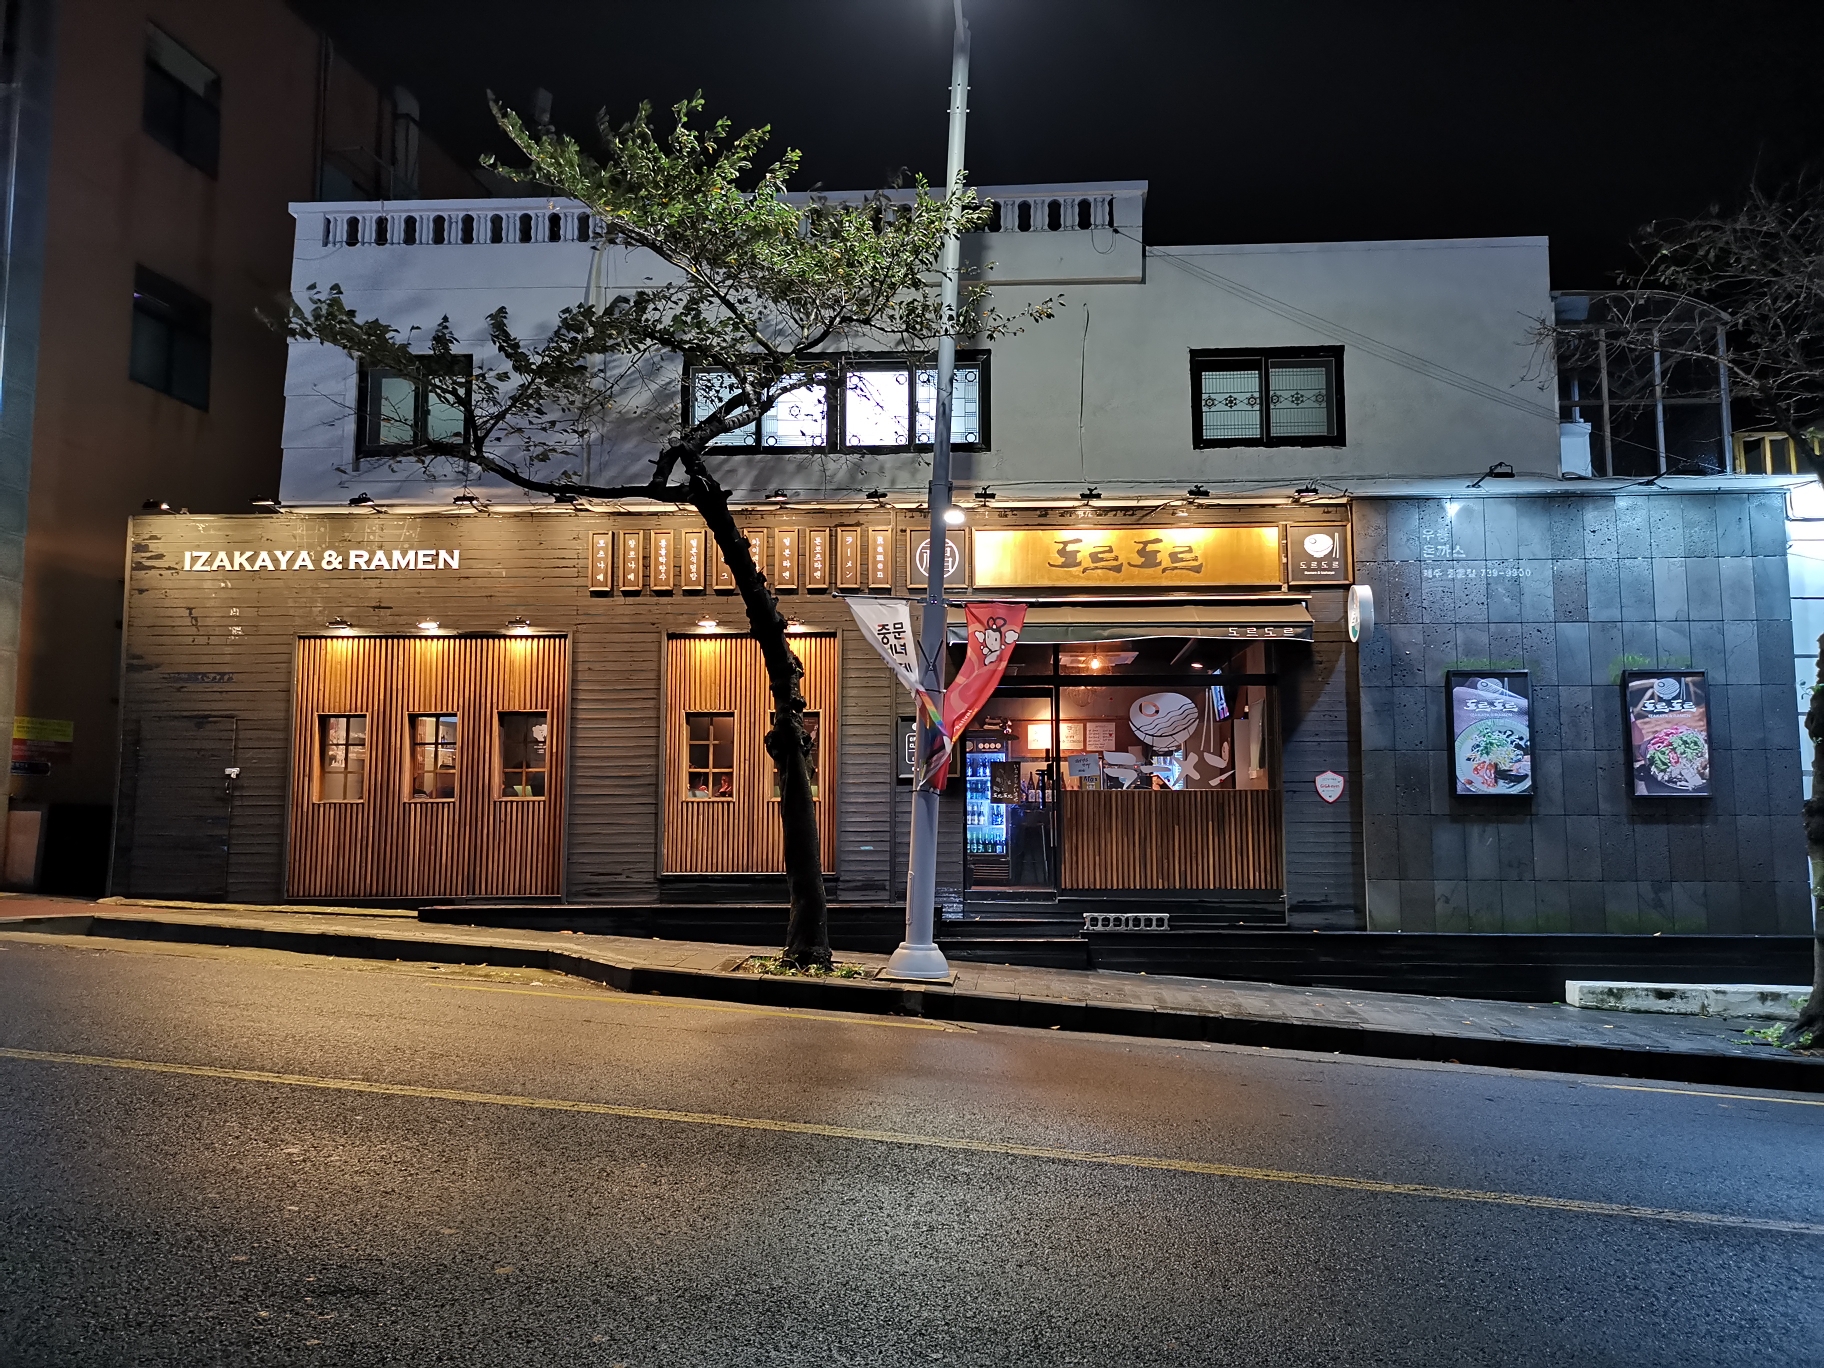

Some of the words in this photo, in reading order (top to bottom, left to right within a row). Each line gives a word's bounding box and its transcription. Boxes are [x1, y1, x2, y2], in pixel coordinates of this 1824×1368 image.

[183, 550, 315, 571] IZAKAYA
[321, 549, 343, 570] &
[347, 549, 460, 570] RAMEN
[596, 539, 606, 582] 모츠나베
[627, 538, 636, 582] 창코나베
[782, 537, 791, 580] 일본라멘
[813, 536, 823, 580] 돈코츠라멘
[845, 536, 853, 578] ラーメン
[876, 536, 884, 578] Ramen
[1048, 538, 1204, 574] 도르도르
[1299, 561, 1339, 569] 도르도르
[1422, 544, 1466, 558] 돈까스
[877, 621, 907, 646] 중문
[1228, 627, 1295, 637] 도르도르
[1463, 699, 1519, 712] 도르도르
[1641, 699, 1697, 712] 도르도르
